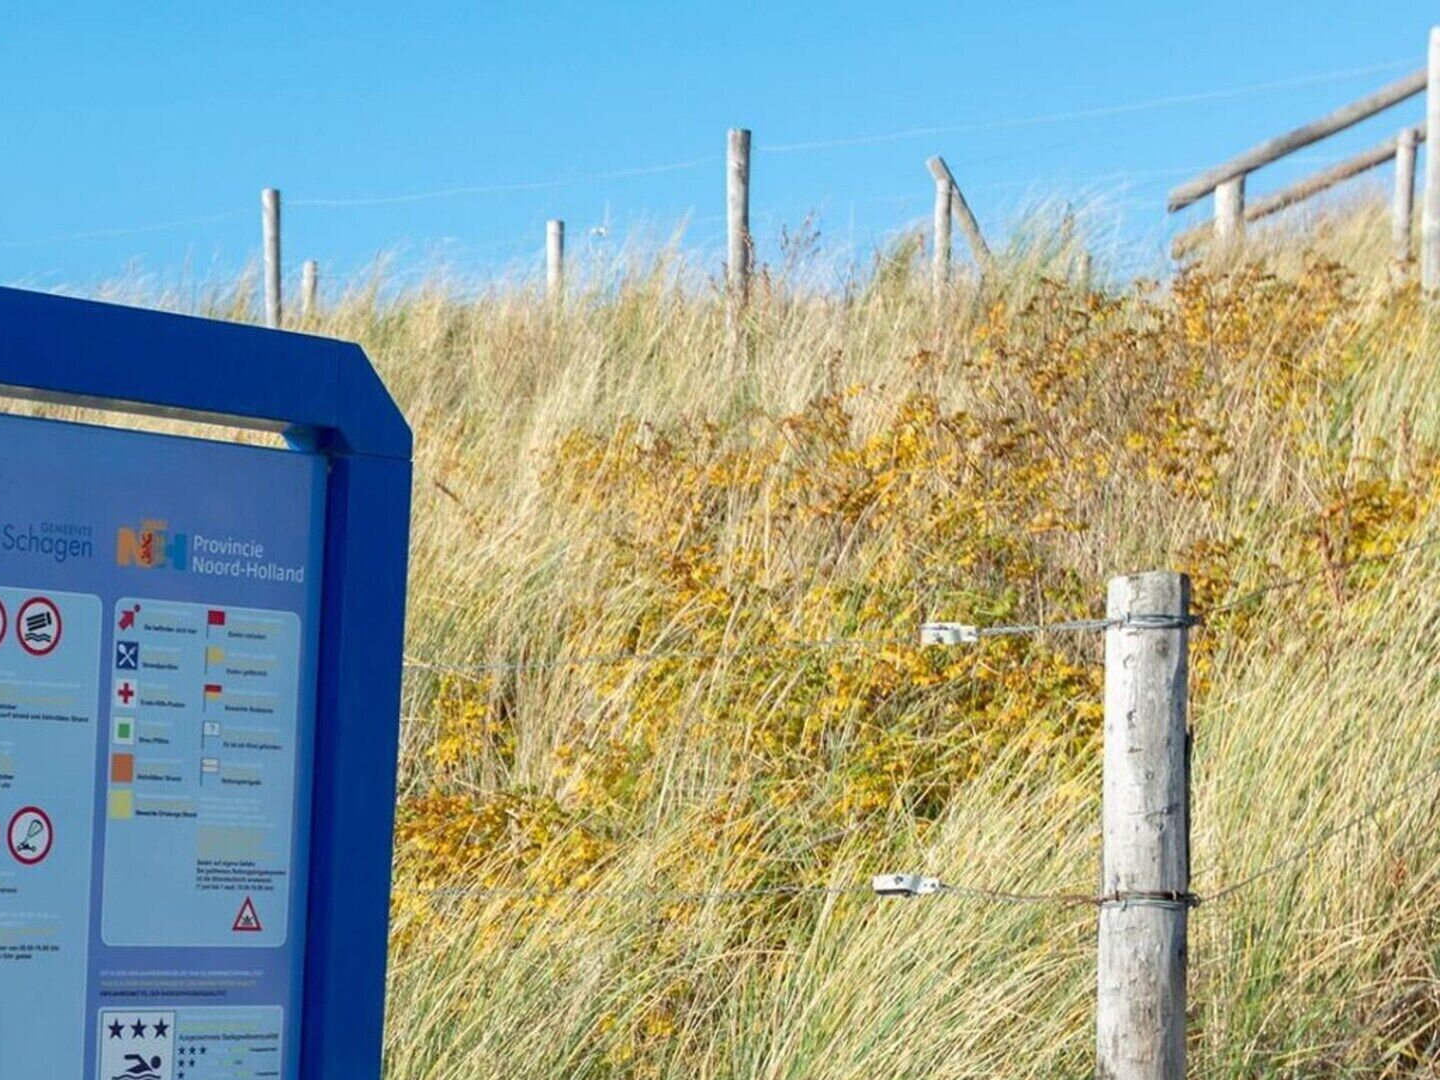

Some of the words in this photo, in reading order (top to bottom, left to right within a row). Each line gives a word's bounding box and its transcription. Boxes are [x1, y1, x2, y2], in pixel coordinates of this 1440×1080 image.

[2, 524, 93, 562] Schagen
[193, 535, 264, 558] Provincie
[192, 557, 305, 584] Noord-Holland
